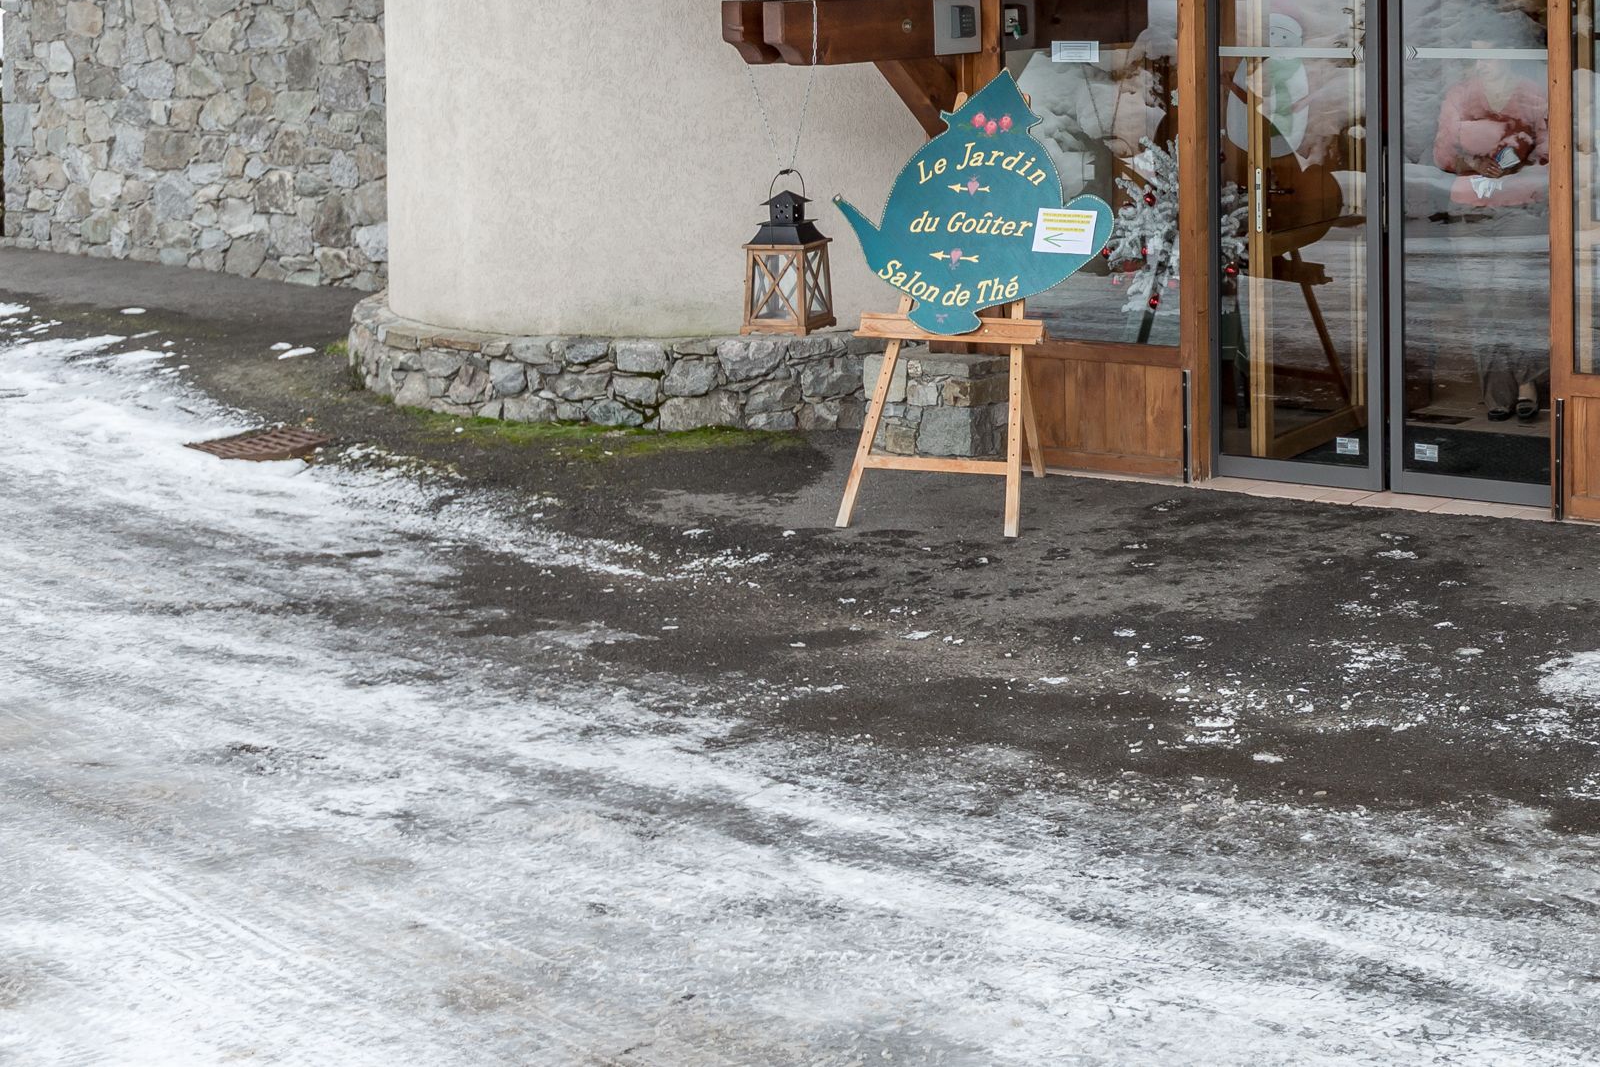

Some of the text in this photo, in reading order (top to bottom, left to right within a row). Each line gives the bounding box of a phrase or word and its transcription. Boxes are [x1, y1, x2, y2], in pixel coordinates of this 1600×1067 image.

[916, 141, 1048, 187] Le Jardin
[909, 210, 1034, 237] du Goûter
[877, 258, 1019, 307] Salon de Thé
